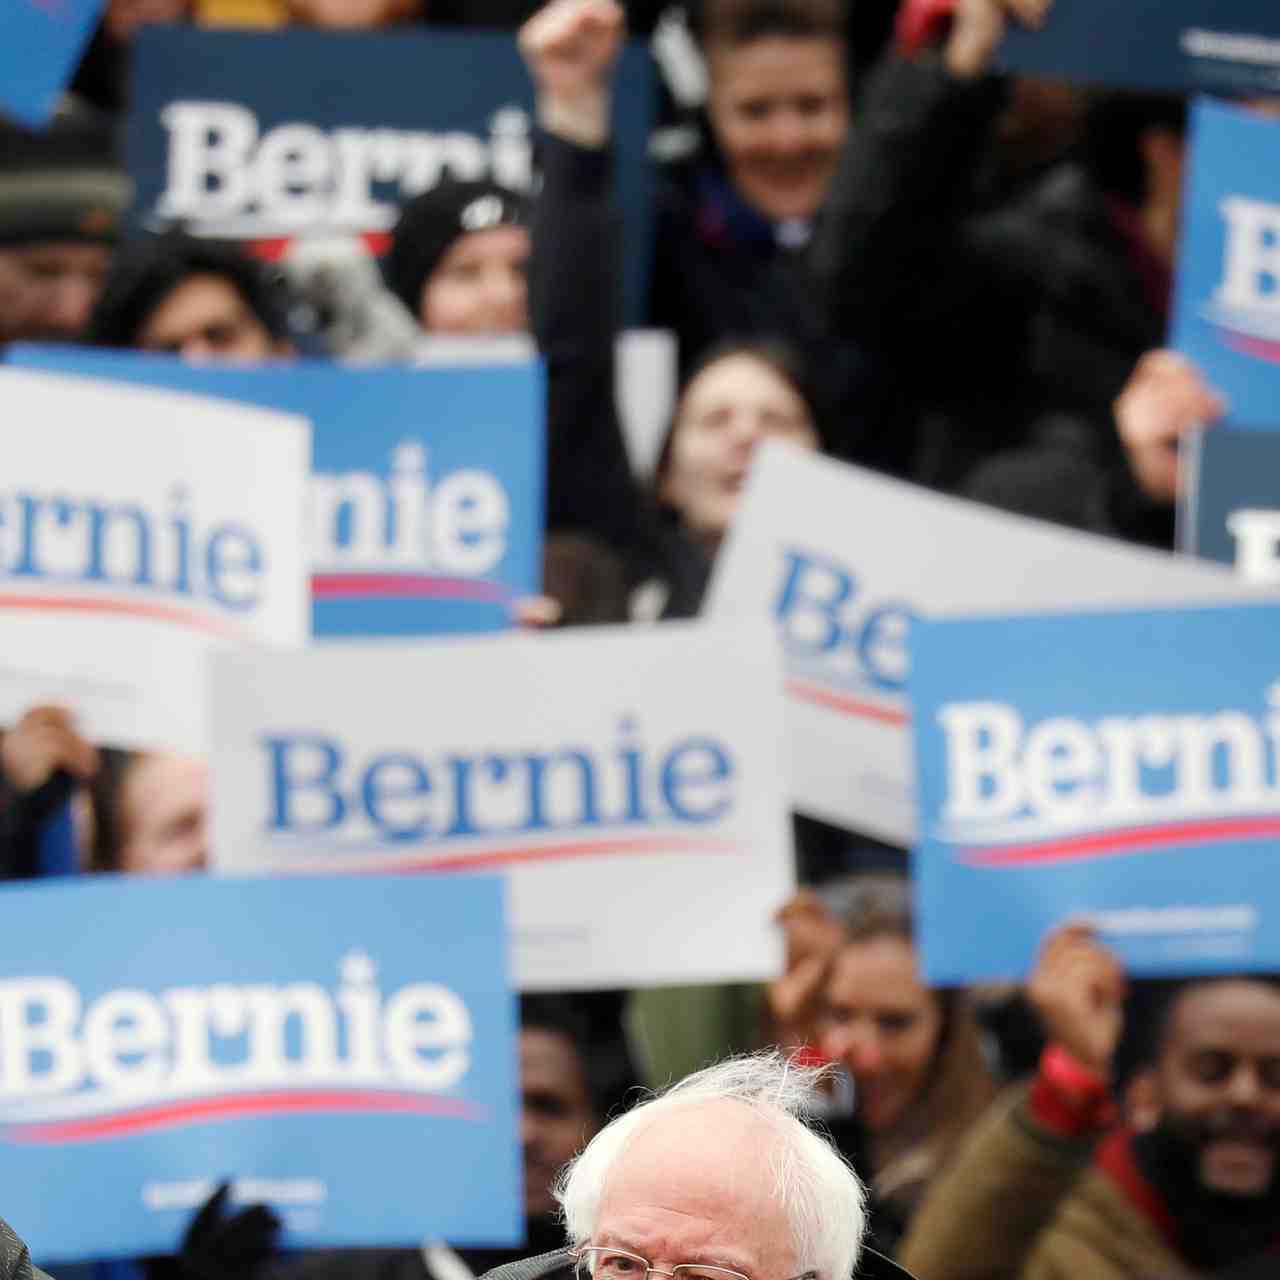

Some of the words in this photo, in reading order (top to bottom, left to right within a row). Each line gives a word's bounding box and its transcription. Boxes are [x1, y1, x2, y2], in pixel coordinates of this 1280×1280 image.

[157, 100, 535, 226] Berni
[312, 438, 509, 575] nie
[258, 712, 736, 841] Bernie
